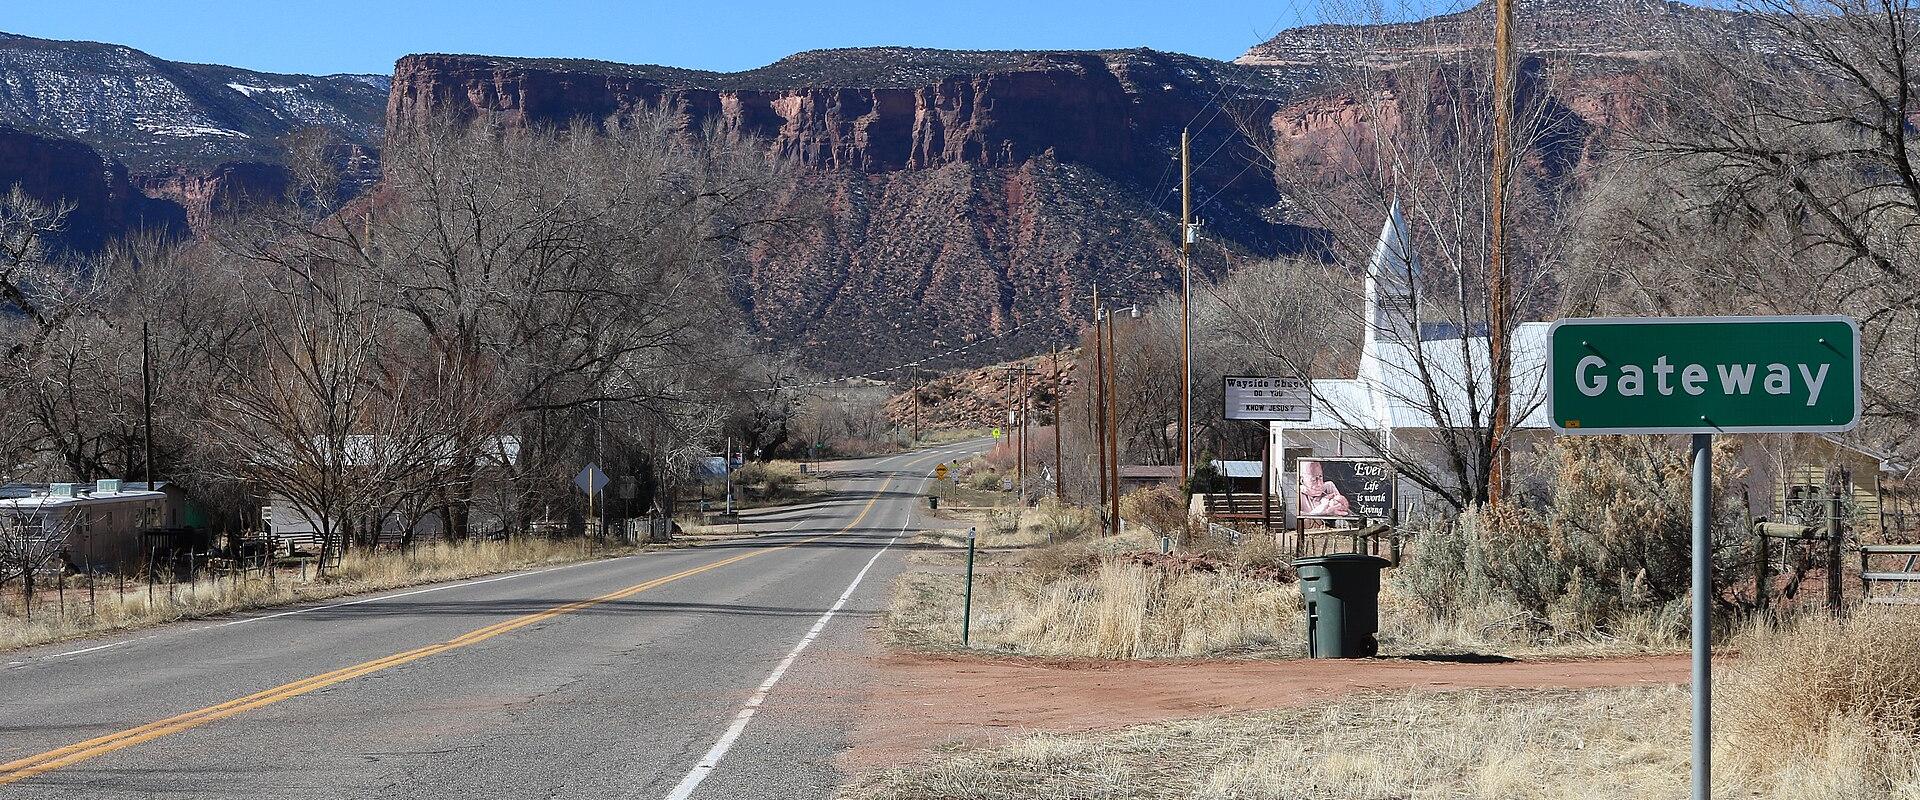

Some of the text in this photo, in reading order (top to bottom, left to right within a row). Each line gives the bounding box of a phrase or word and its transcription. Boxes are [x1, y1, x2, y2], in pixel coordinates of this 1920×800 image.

[1227, 379, 1269, 389] Wayside
[1575, 355, 1830, 406] Gateway
[1246, 404, 1295, 412] KNOW JESUS?
[1363, 480, 1379, 493] Life
[1364, 491, 1386, 502] worth
[1360, 504, 1384, 517] Living
